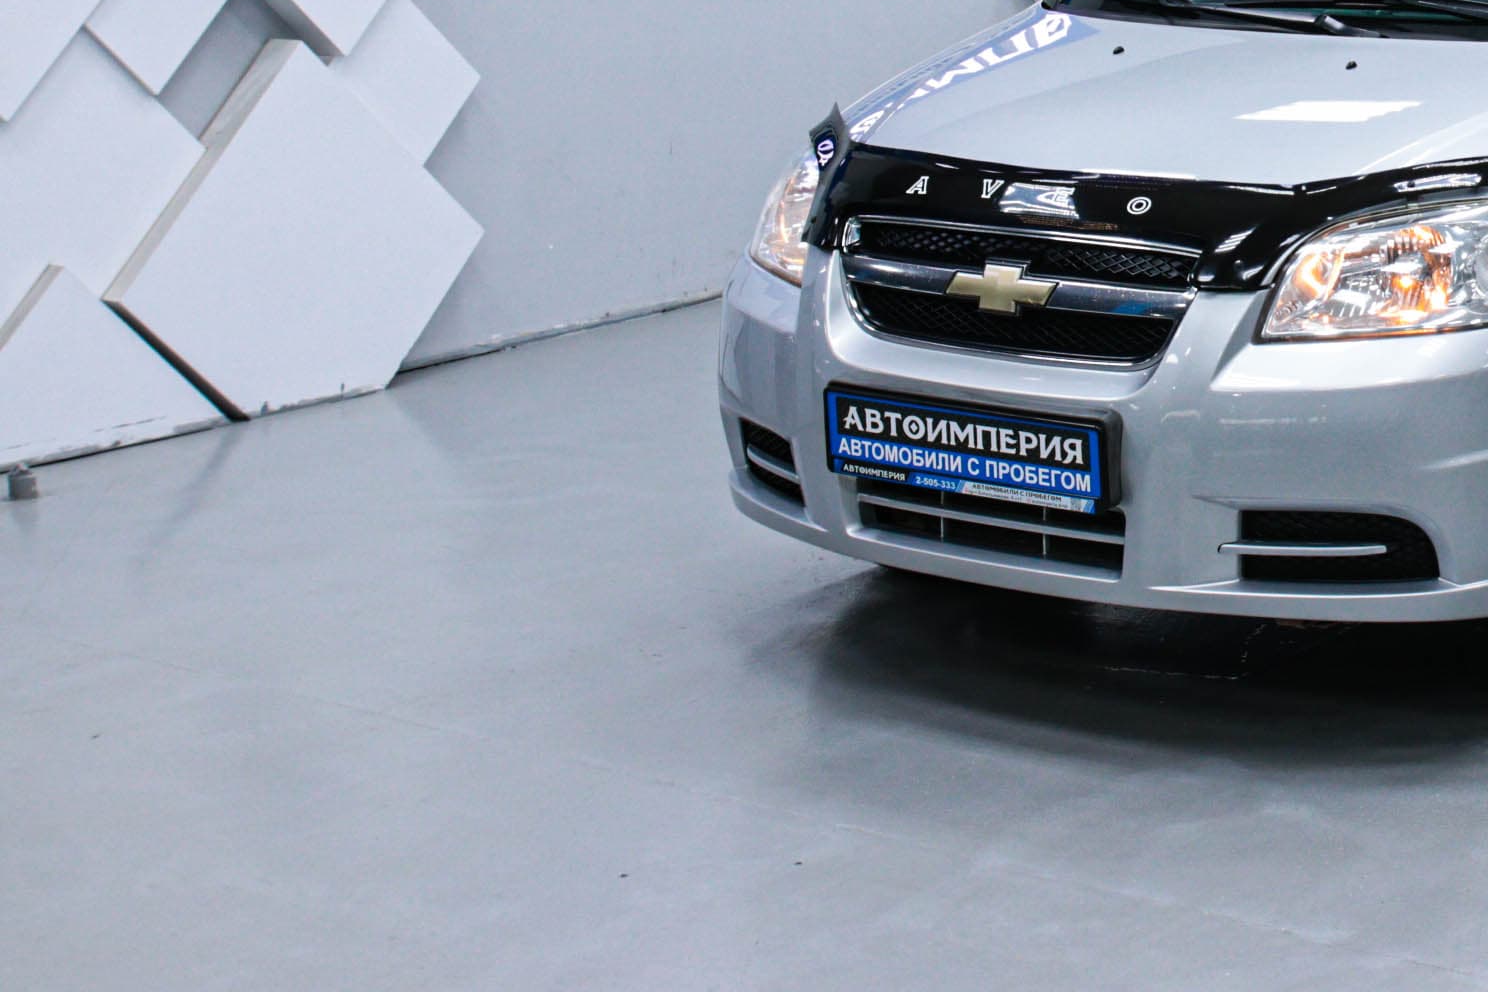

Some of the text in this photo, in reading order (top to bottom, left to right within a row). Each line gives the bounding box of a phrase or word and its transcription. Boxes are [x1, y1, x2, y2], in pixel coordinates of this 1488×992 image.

[843, 405, 1084, 465] АВТОИМПЕРИЯ
[838, 437, 1091, 494] АВТОМОБИЛИ С ПРОБЕГОМ
[843, 463, 956, 491] АВТОИМПЕРИЯ 2-505-333
